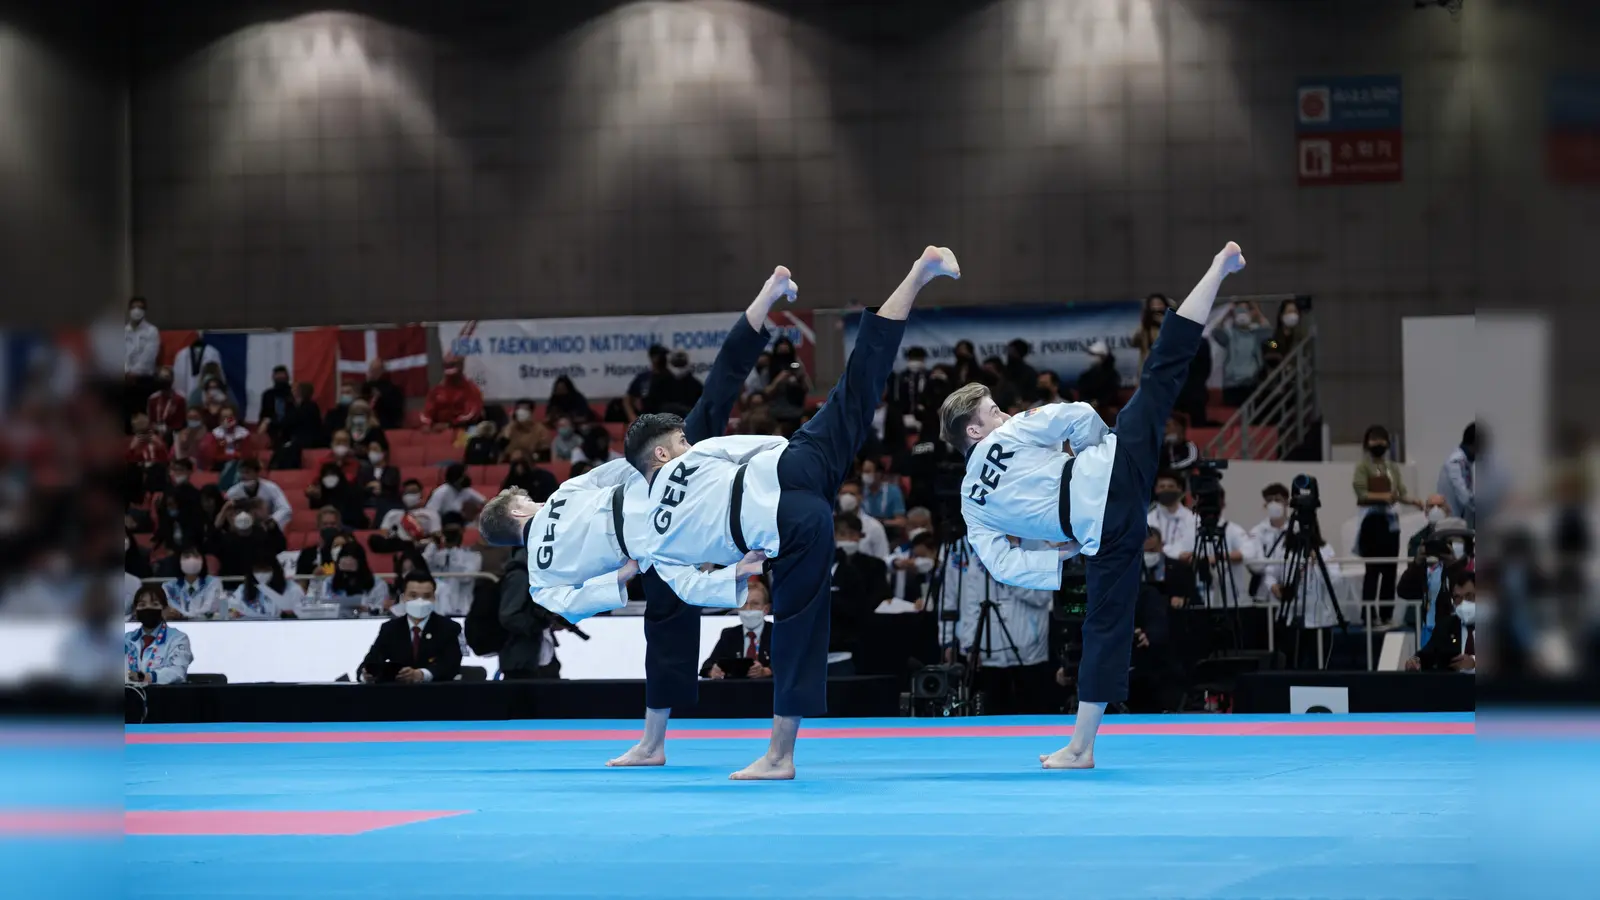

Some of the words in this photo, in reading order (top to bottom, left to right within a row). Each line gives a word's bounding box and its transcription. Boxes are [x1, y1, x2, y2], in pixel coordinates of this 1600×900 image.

[451, 336, 482, 355] USA
[488, 335, 585, 354] TAEKWONDO
[673, 329, 729, 350] POOMS
[604, 361, 650, 377] Hono
[969, 442, 1015, 506] GER
[653, 461, 700, 535] GER
